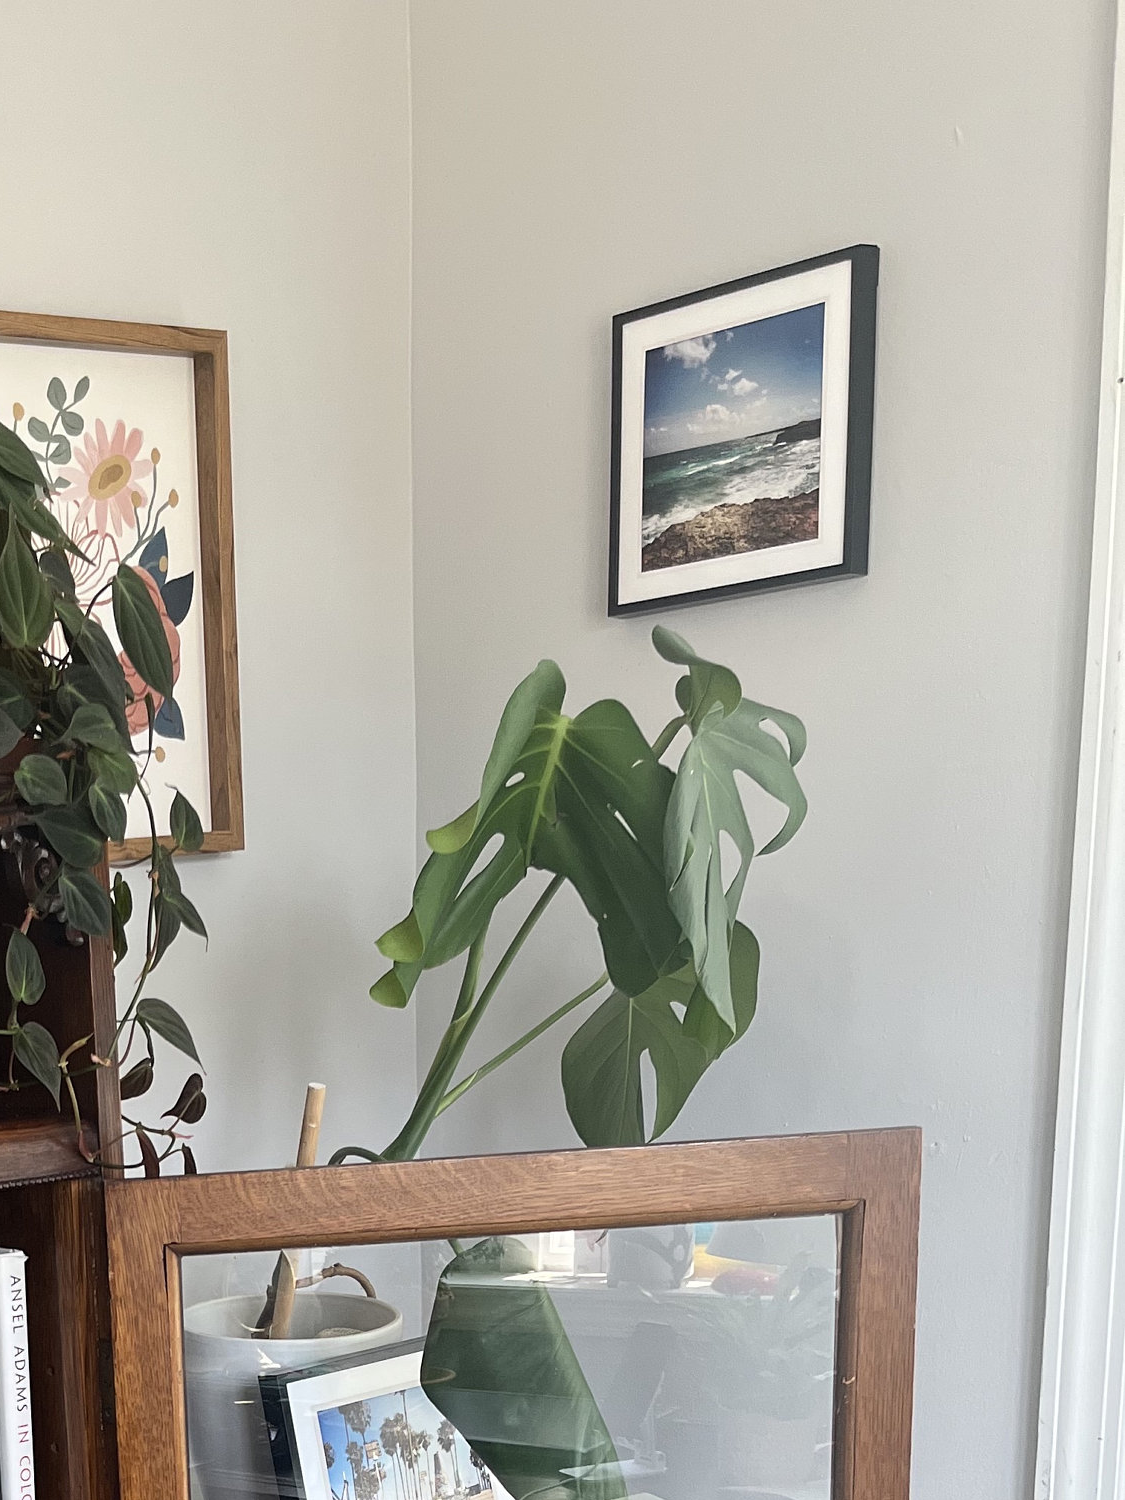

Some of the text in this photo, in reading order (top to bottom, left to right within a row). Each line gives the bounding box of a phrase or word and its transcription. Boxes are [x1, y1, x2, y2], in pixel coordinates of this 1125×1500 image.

[10, 1275, 24, 1334] ANSEL
[14, 1345, 28, 1412] ADAMS
[17, 1424, 29, 1443] IN
